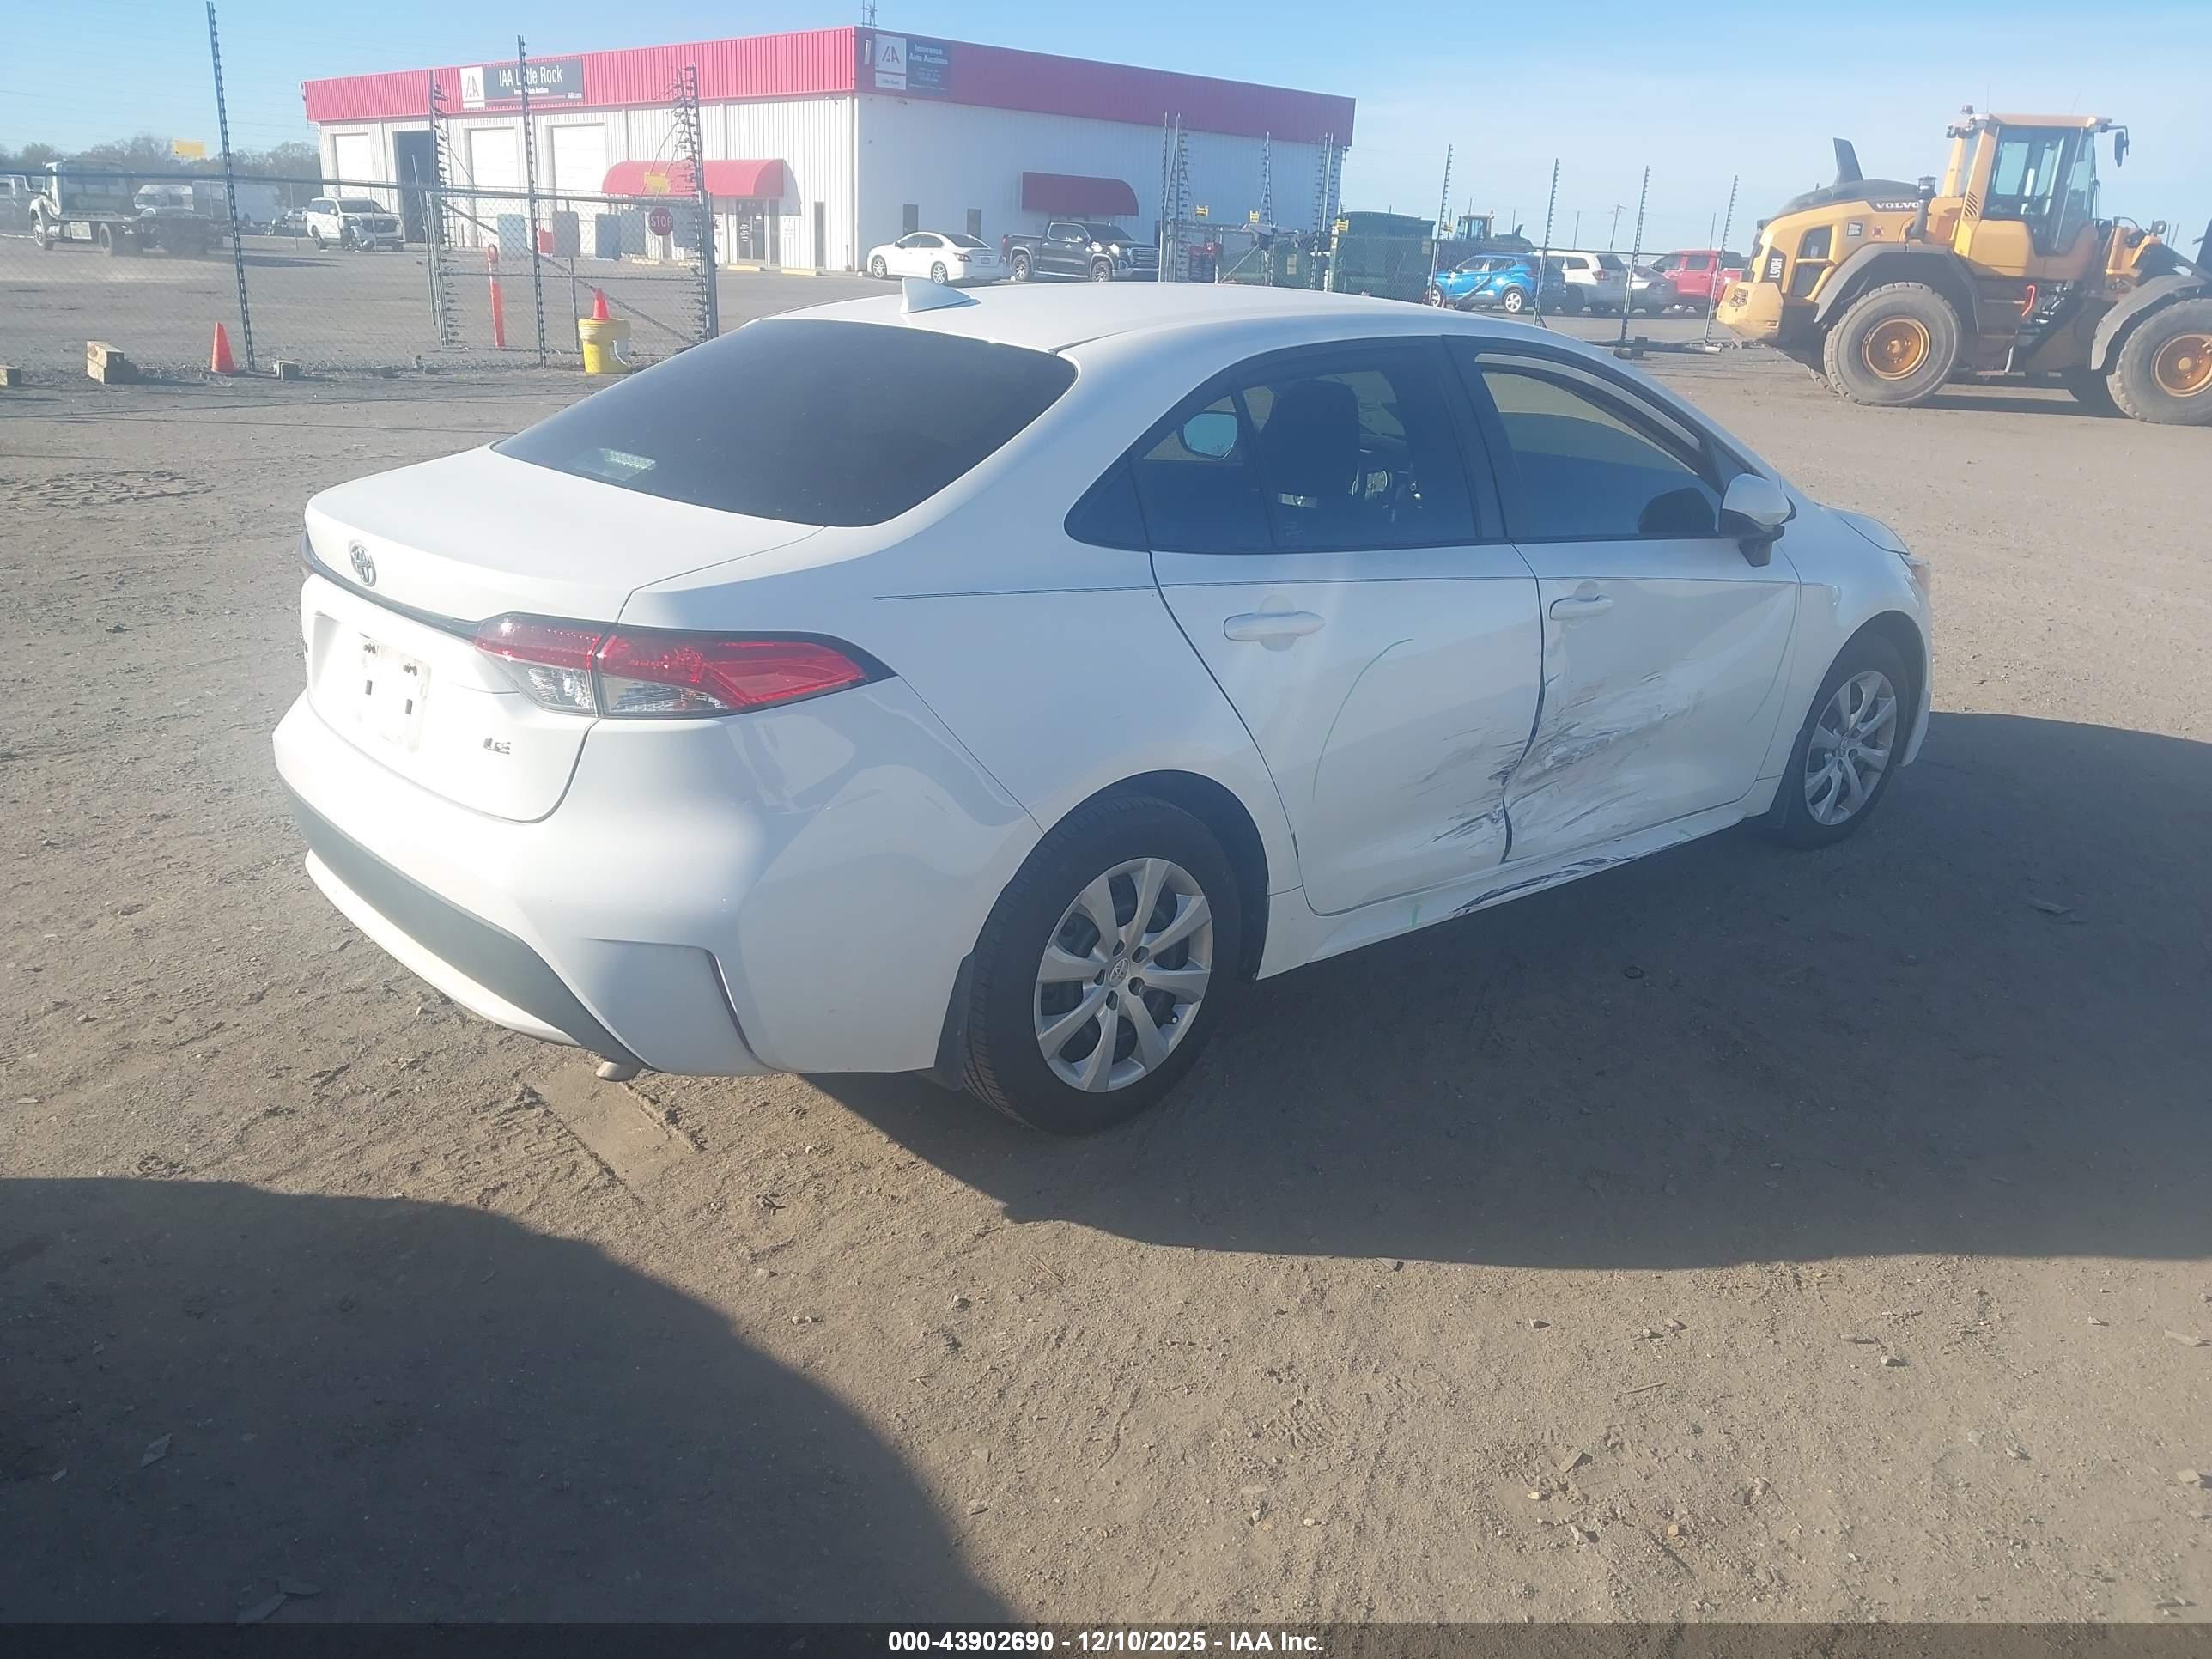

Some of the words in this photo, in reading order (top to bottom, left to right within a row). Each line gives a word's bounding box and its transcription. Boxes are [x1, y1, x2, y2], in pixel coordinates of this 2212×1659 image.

[499, 70, 514, 87] IAA
[540, 64, 563, 83] Rock
[651, 216, 672, 228] STOP
